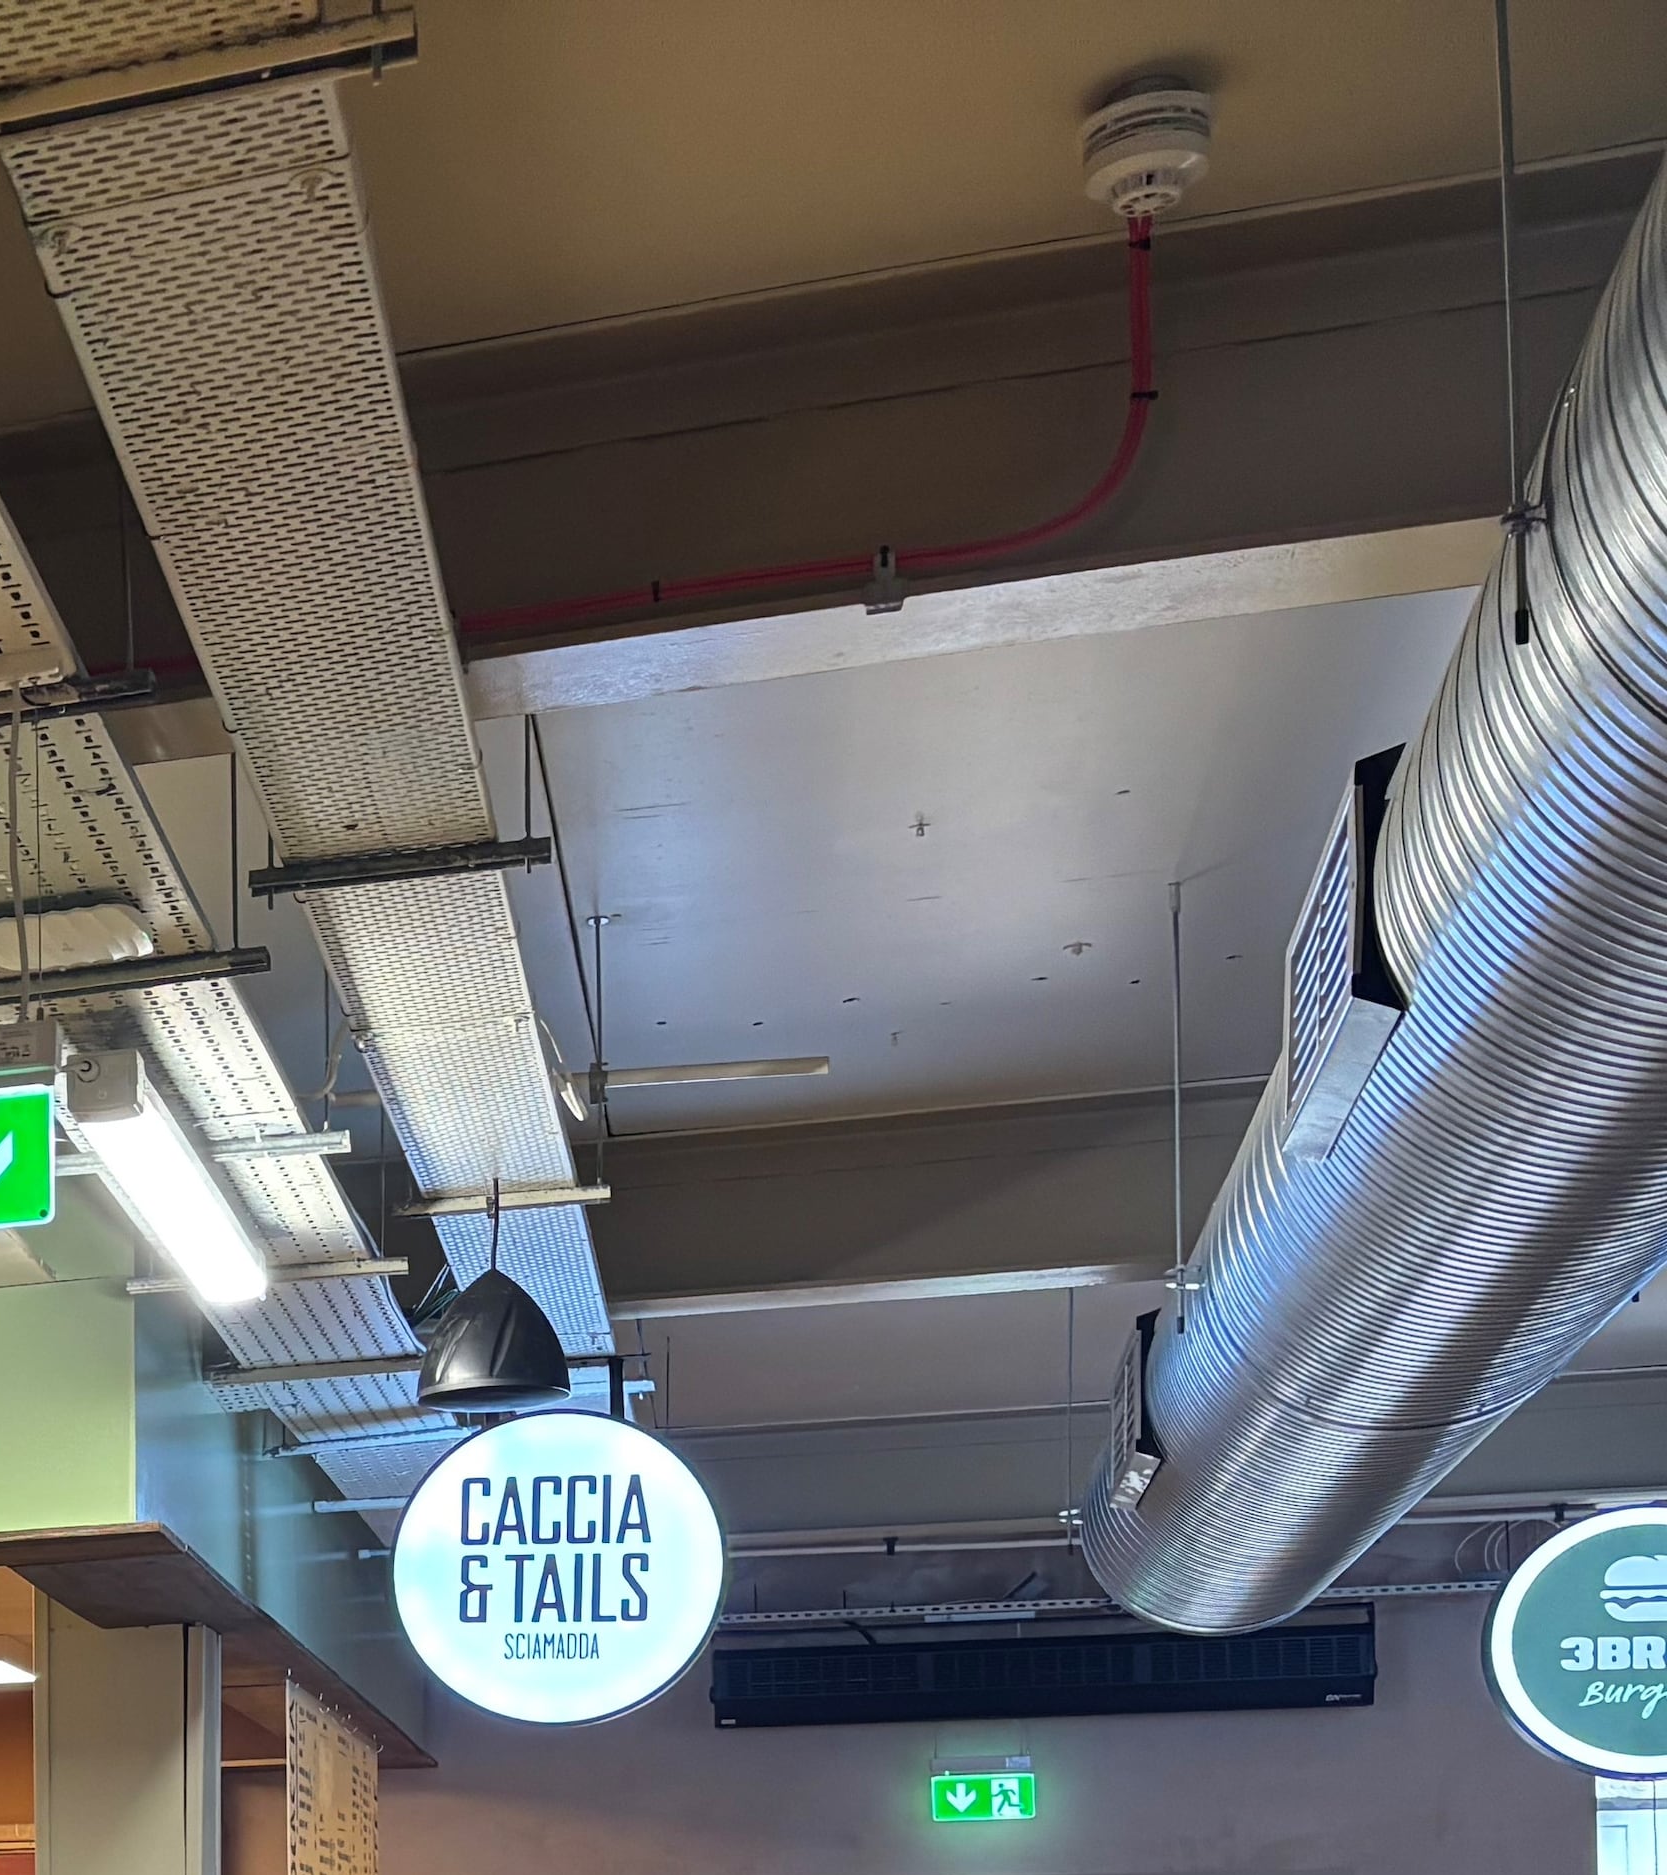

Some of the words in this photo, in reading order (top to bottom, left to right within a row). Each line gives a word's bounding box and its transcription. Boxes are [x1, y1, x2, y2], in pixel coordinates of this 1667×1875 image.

[461, 1474, 651, 1546] CACCIA
[459, 1555, 493, 1623] &
[505, 1553, 649, 1623] TAILS
[504, 1633, 600, 1660] SCIAMADDA
